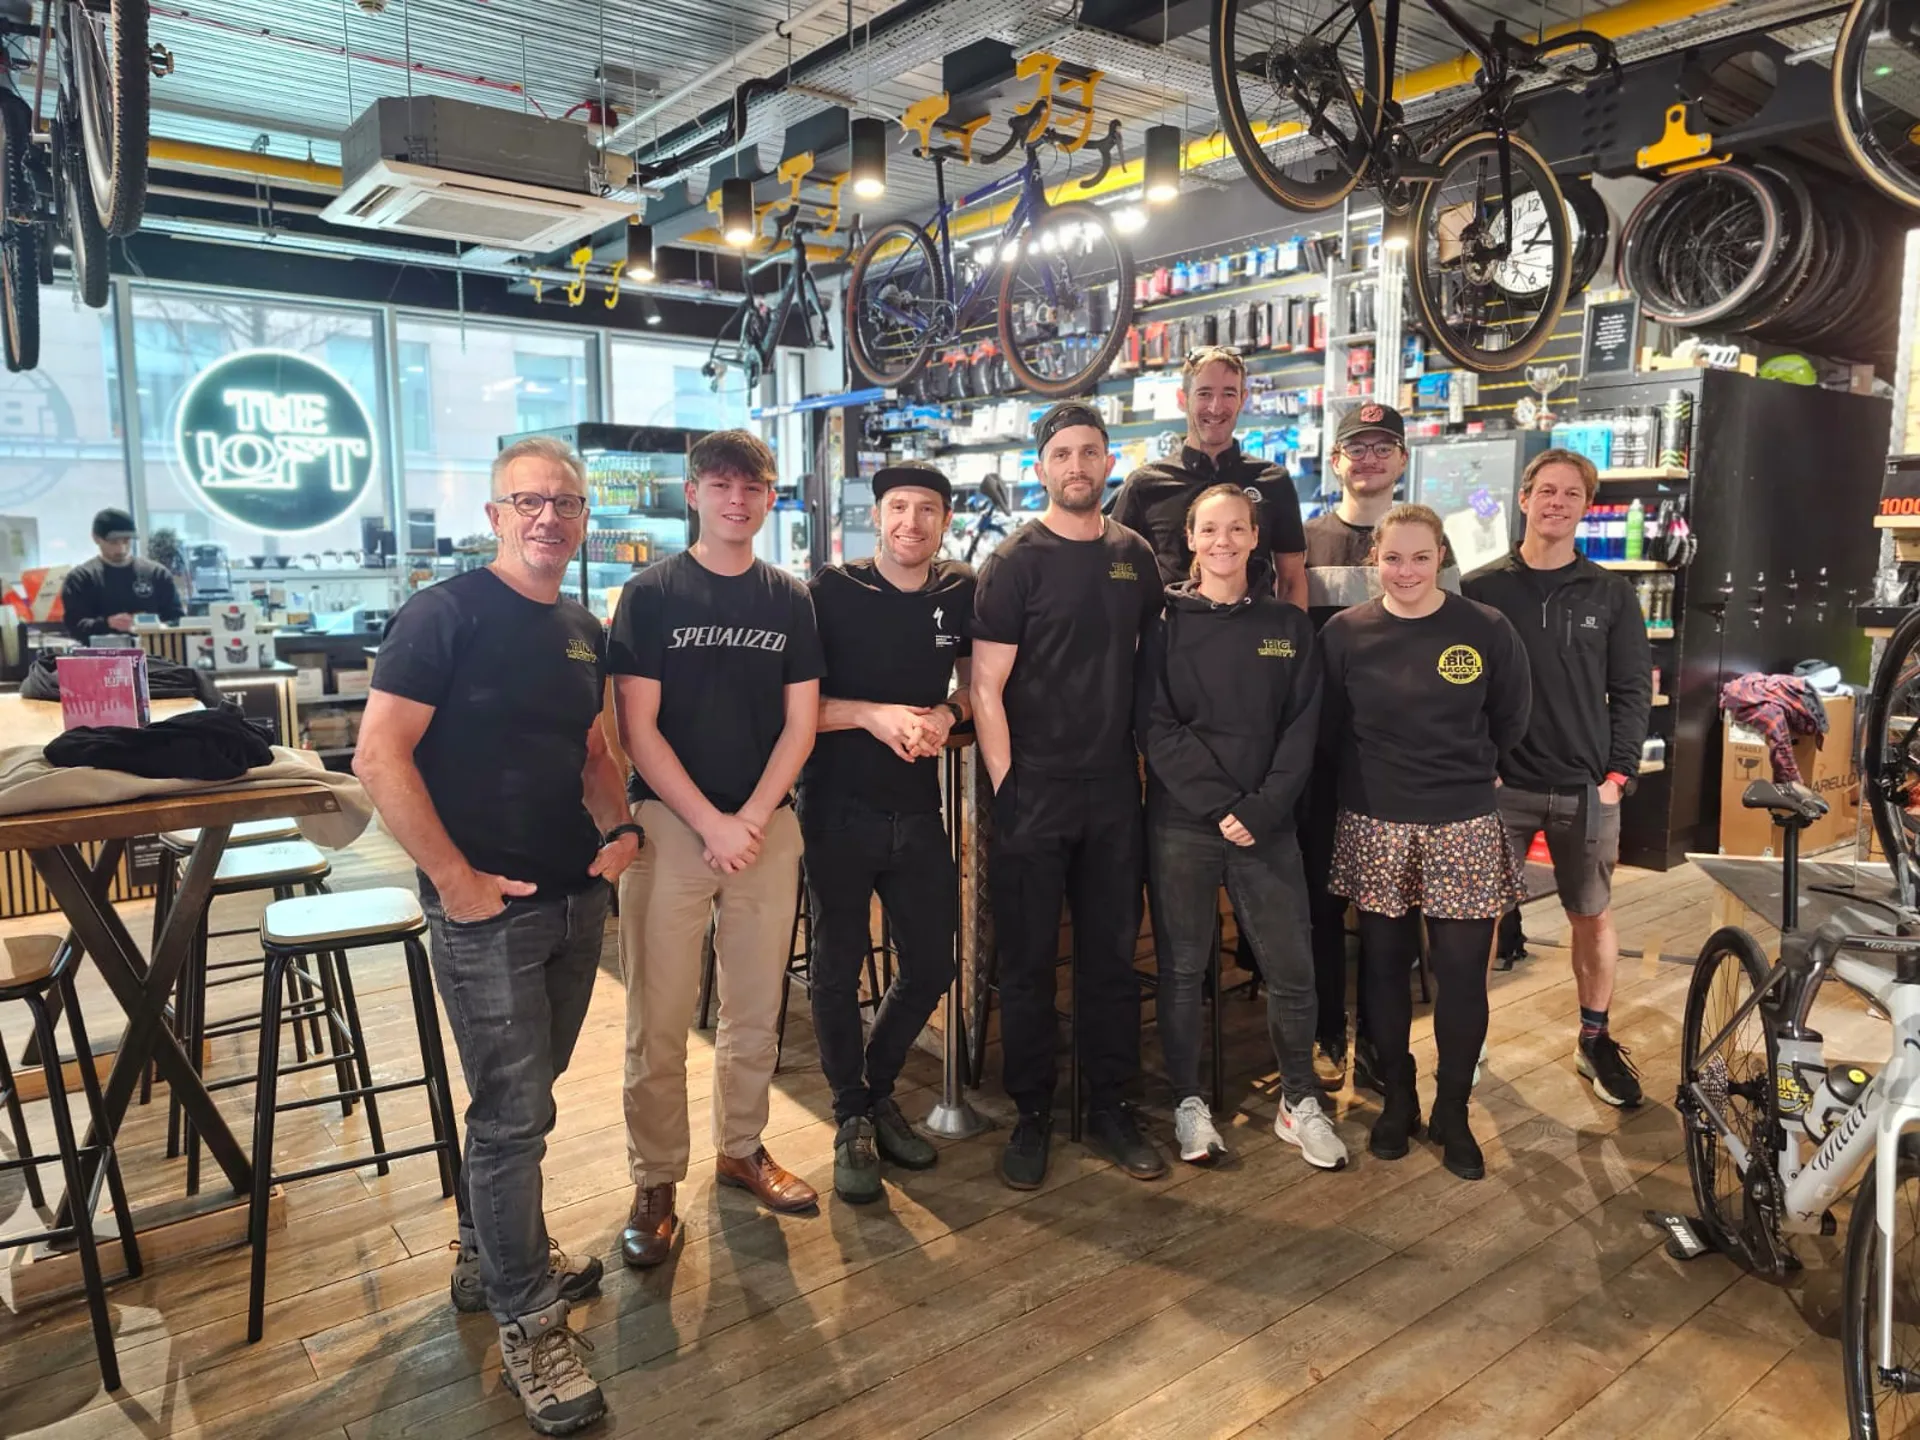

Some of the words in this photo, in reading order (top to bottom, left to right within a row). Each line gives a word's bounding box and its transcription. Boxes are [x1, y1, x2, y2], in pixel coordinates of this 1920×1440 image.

[1528, 198, 1540, 212] 12
[1511, 269, 1520, 284] 7
[1528, 271, 1537, 285] 6
[222, 388, 329, 435] THE
[195, 430, 368, 492] LOFT
[667, 625, 787, 652] SPECIALIZED
[1445, 654, 1476, 667] BIG
